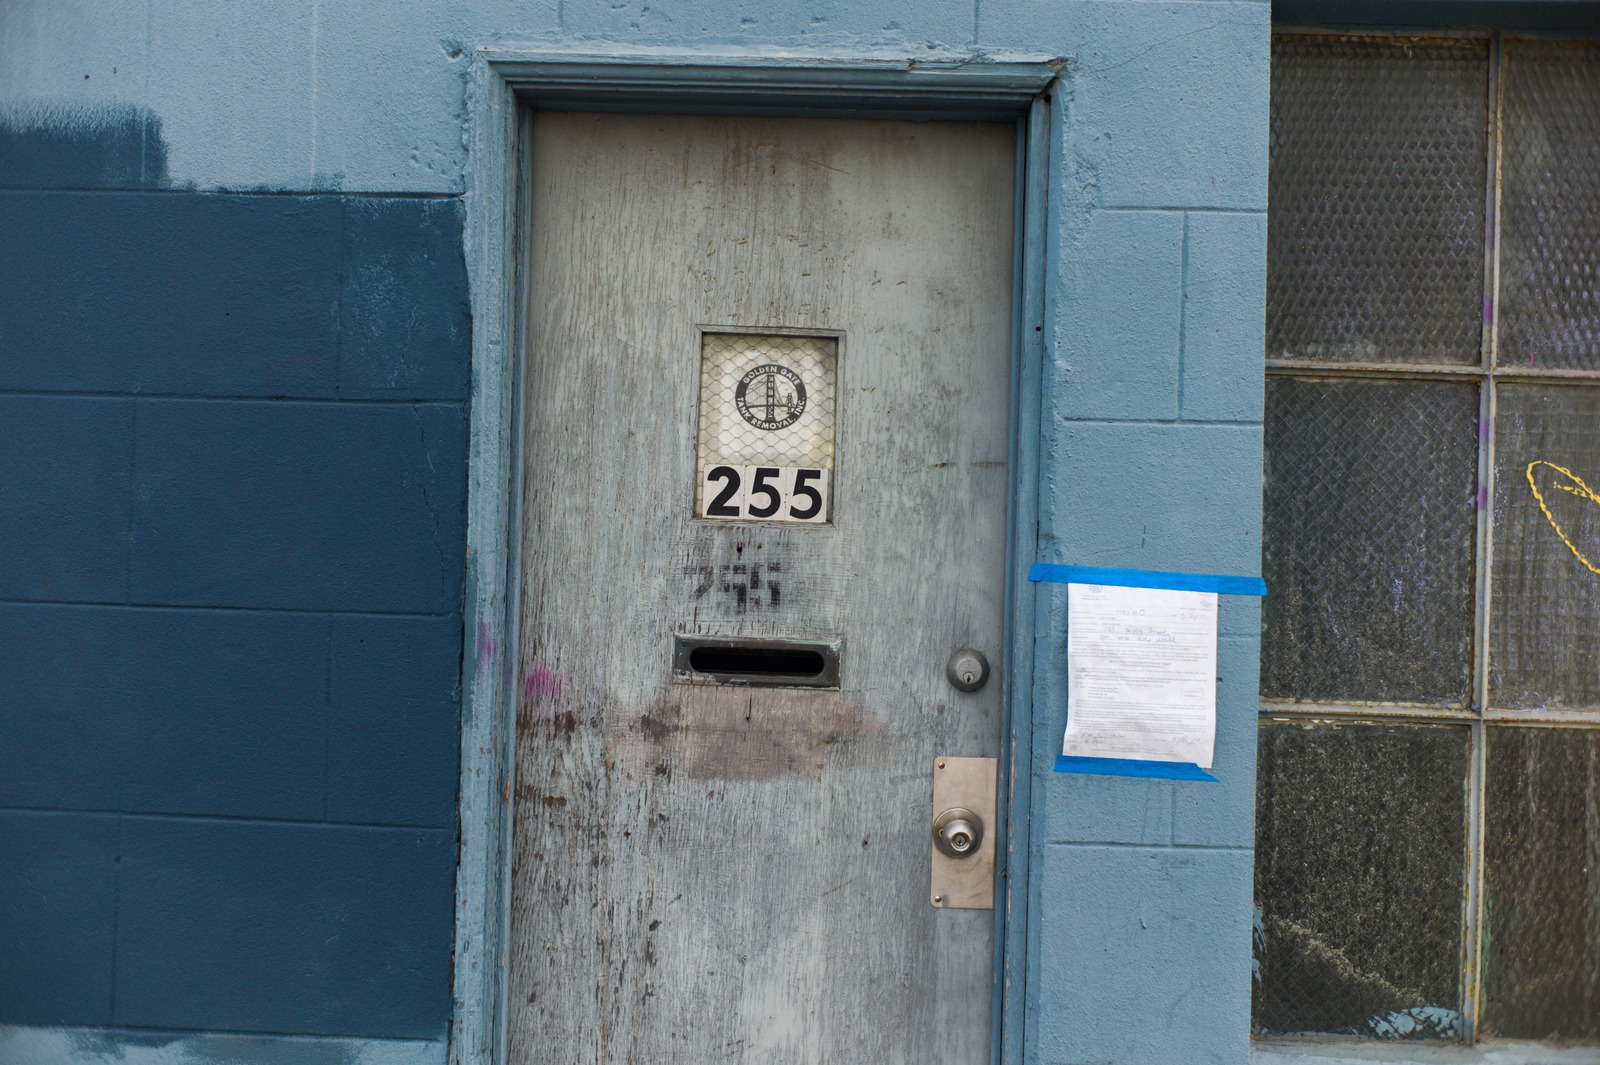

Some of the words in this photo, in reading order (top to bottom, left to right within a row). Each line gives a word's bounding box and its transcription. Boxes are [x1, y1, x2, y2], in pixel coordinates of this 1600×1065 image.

[742, 365, 778, 384] GOLDEN
[780, 368, 801, 385] GATE
[736, 397, 752, 420] TANK
[706, 465, 823, 520] 255
